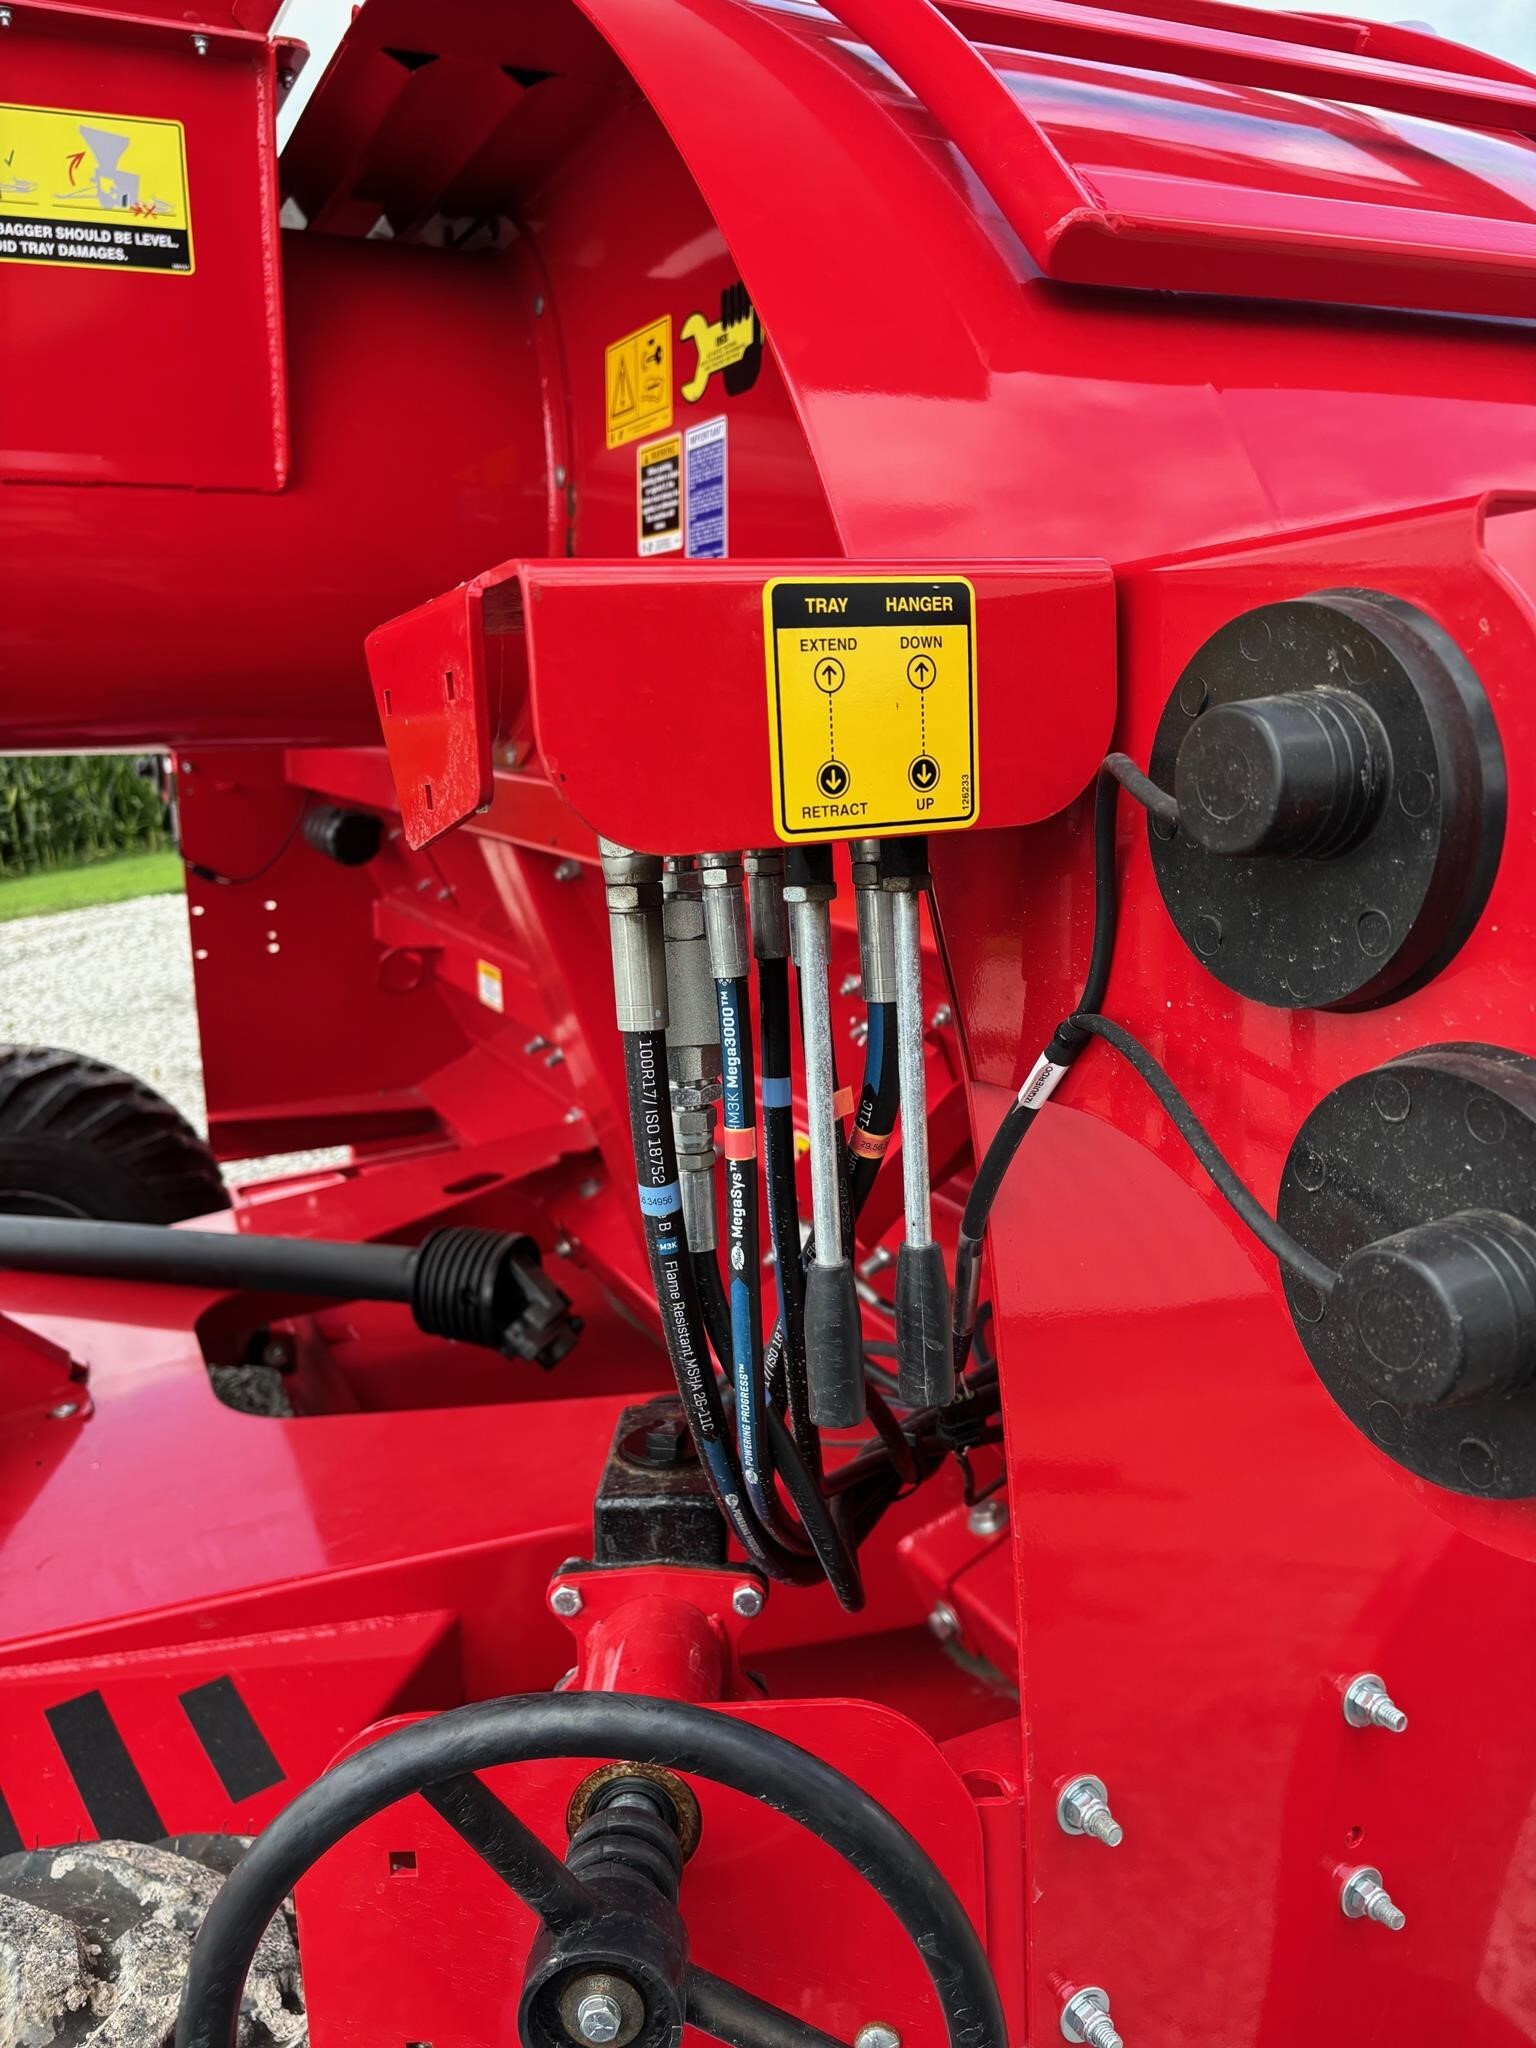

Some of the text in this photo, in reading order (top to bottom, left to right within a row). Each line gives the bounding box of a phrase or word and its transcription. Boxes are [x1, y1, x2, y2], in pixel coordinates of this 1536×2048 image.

[55, 226, 112, 243] SHOULD
[113, 231, 133, 245] BE
[19, 240, 55, 256] TRAY
[58, 243, 129, 261] DAMAGES.
[805, 597, 848, 613] TRAY
[886, 596, 953, 612] HANGER
[800, 638, 858, 652] EXTEND
[900, 635, 943, 649] DOWN
[961, 774, 970, 811] 126233
[802, 802, 869, 819] RETRACT
[916, 797, 935, 810] UP
[1024, 1066, 1054, 1104] IZQUIERDO
[645, 1109, 660, 1135] ISO
[648, 1138, 666, 1185] 18752
[658, 1222, 672, 1232] B
[660, 1241, 678, 1251] M3K
[664, 1260, 681, 1300] Flame
[685, 1358, 703, 1392] MSHA
[768, 1348, 779, 1368] ISO
[741, 1424, 754, 1467] POWERING
